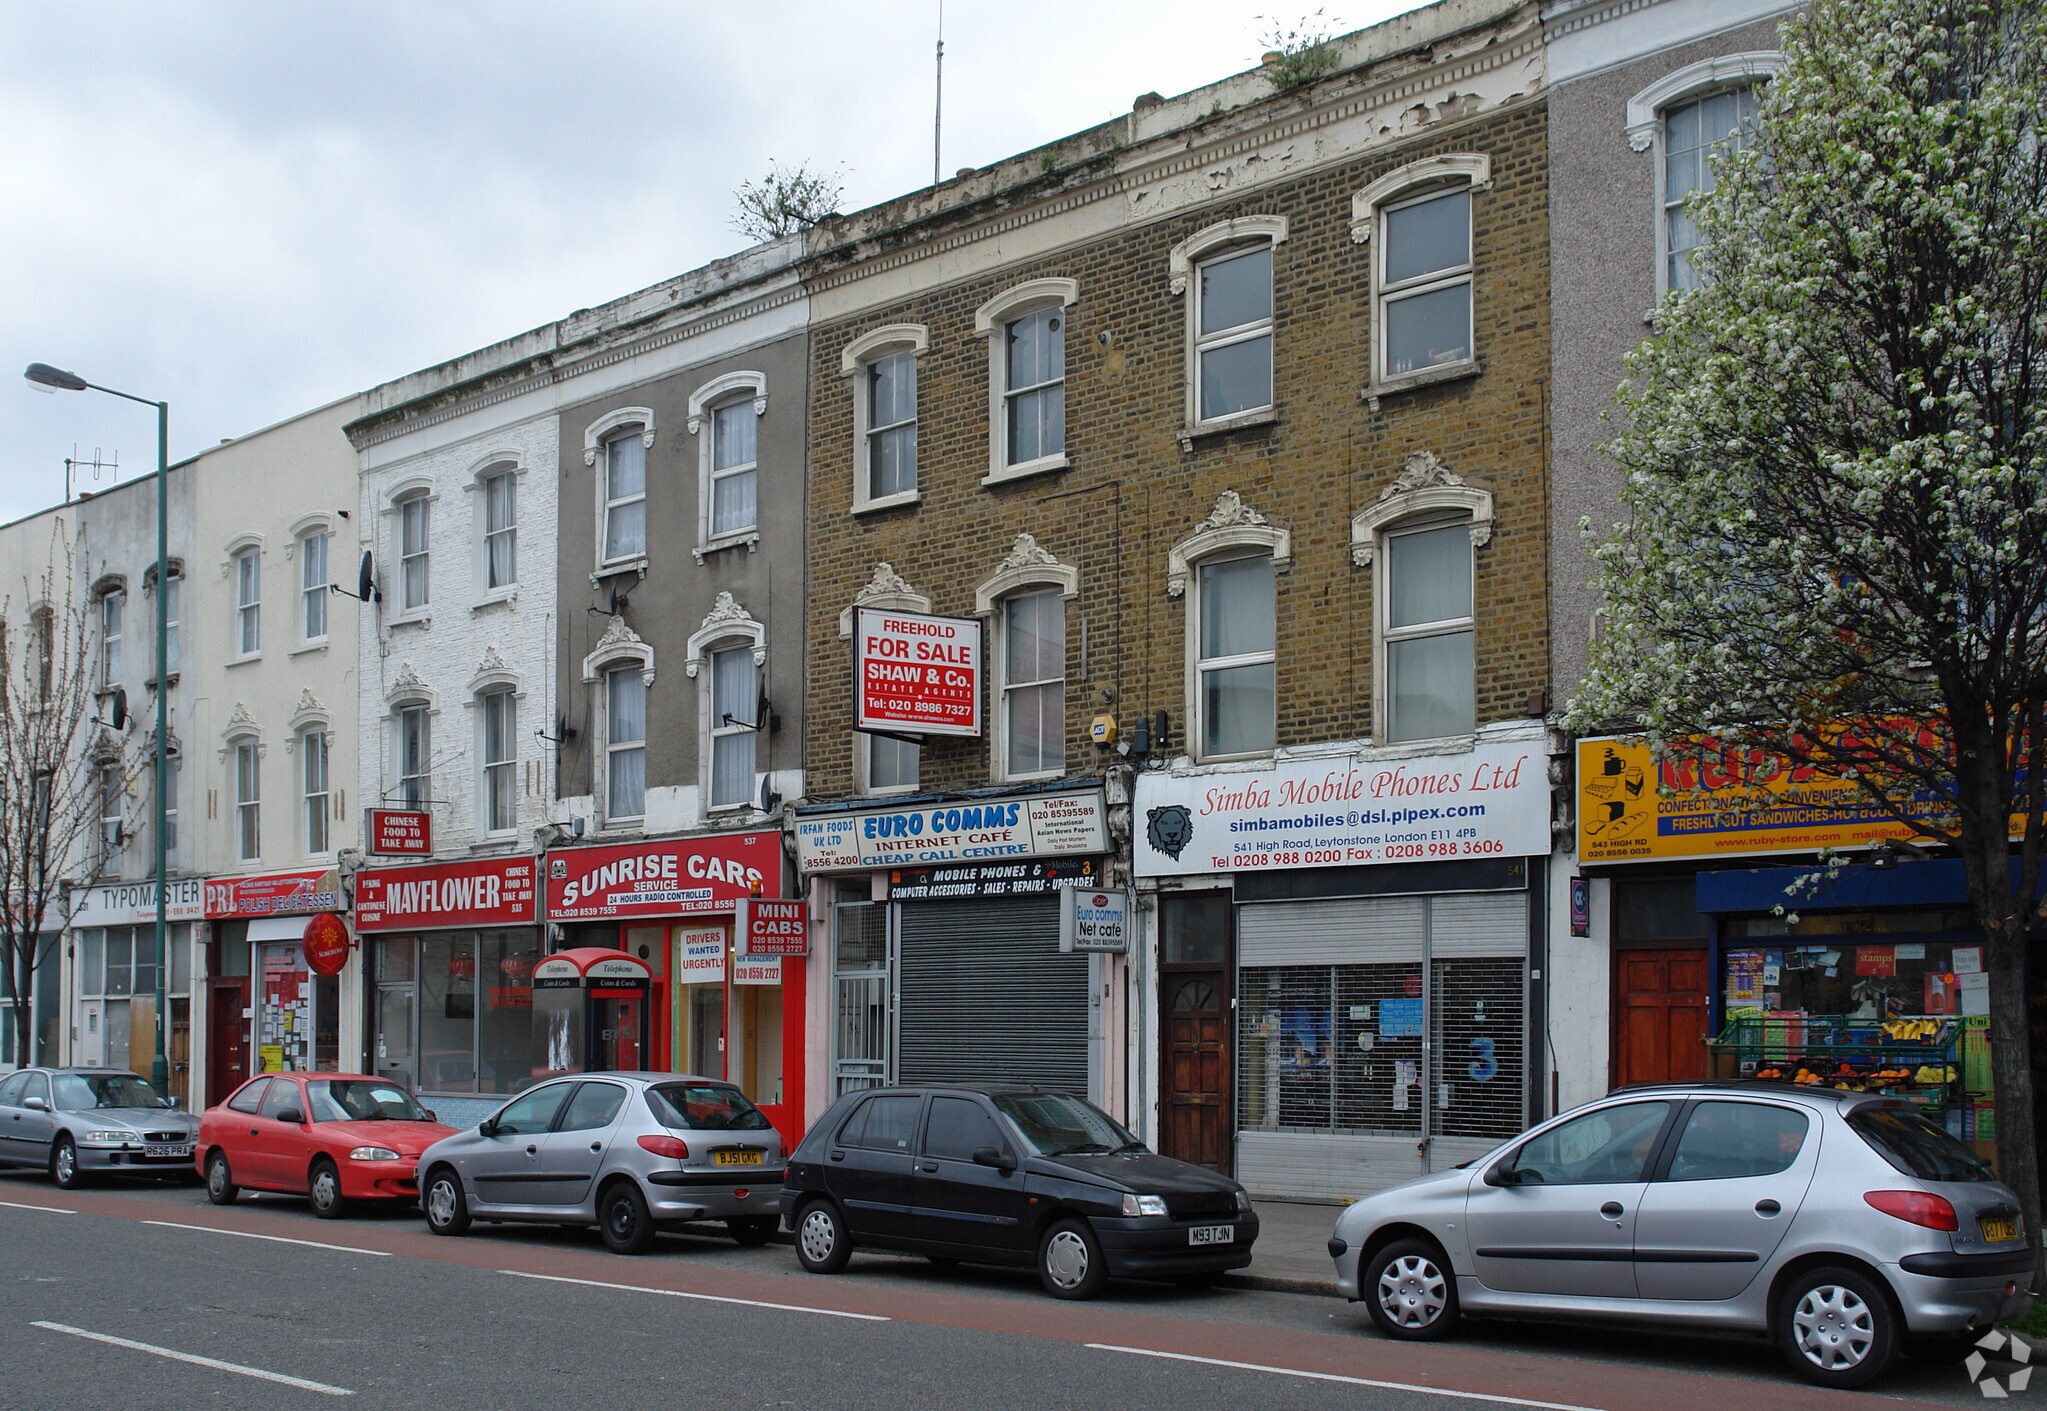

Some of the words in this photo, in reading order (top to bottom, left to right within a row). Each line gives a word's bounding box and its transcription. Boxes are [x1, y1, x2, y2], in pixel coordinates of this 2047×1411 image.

[884, 620, 955, 638] FREEHOLD
[867, 636, 909, 658] FOR
[916, 641, 971, 665] SALE
[868, 663, 921, 683] SHAW
[926, 668, 940, 685] &
[945, 670, 971, 688] Co.
[868, 682, 913, 693] ESTATE
[924, 687, 971, 698] AGENTS
[867, 697, 887, 709] Tel:
[888, 699, 911, 711] 020
[914, 702, 942, 713] 8986
[945, 704, 971, 716] 7327
[1199, 780, 1271, 816] Simba
[1278, 769, 1363, 807] Mobile
[1370, 765, 1462, 798] Phones
[1468, 755, 1529, 792] Ltd
[1043, 800, 1078, 809] Tel/Fax:
[1032, 811, 1048, 820] 020
[1050, 807, 1095, 818] 85395589
[1230, 804, 1486, 832] simbamobiles@dsl.pipex.com
[384, 816, 419, 827] CHINESE
[800, 823, 823, 835] IRFAN
[827, 821, 853, 832] FOODS
[864, 812, 923, 840] EURO
[931, 803, 1020, 833] COMMS
[1045, 819, 1084, 828] International
[1672, 817, 1719, 831] FRESHLY
[384, 825, 407, 836] FOOD
[409, 827, 420, 837] TO
[380, 839, 401, 848] TAKE
[404, 839, 424, 849] AWAY
[744, 837, 757, 845] 537
[813, 837, 825, 847] UK
[827, 835, 842, 846] LTD
[876, 835, 961, 852] INTERNET
[968, 829, 1013, 844] CAFÉ
[1234, 842, 1252, 853] 541
[1256, 840, 1280, 852] High
[1283, 838, 1313, 850] Road,
[1315, 835, 1381, 848] Leytonstone
[1385, 831, 1427, 843] London
[1431, 830, 1451, 840] E11
[1456, 828, 1477, 838] 4PB
[1592, 841, 1608, 849] 543
[1610, 839, 1632, 848] HIGH
[1714, 832, 1841, 848] www.ruby-store.com
[862, 852, 914, 866] CHEAP
[918, 848, 958, 861] CALL
[962, 843, 1028, 858] CENTRE
[1212, 856, 1229, 868] Tel
[1234, 854, 1269, 867] 0208
[1273, 852, 1300, 865] 988
[1305, 849, 1342, 863] 0200
[1347, 847, 1373, 860] Fax
[1385, 843, 1424, 859] 0208
[1428, 842, 1458, 856] 988
[1463, 839, 1503, 854] 3606
[1588, 850, 1604, 858] 020
[1630, 848, 1652, 856] 0035
[807, 858, 831, 868] 8556
[834, 855, 858, 866] 4200
[505, 866, 529, 877] CHINESE
[933, 868, 980, 882] MOBILE
[980, 865, 1026, 879] PHONES
[1033, 864, 1042, 876] &
[1082, 861, 1091, 876] 3
[1507, 865, 1524, 876] 541
[504, 880, 521, 889] FOOD
[522, 878, 530, 888] TO
[561, 854, 678, 907] SUNRISE
[686, 854, 765, 894] CARS
[634, 880, 678, 892] SERVICE
[103, 882, 199, 909] TYPOMASTER
[386, 874, 500, 915] MAYFLOWER
[502, 892, 516, 901] TAKE
[518, 890, 532, 900] AWAY
[892, 884, 928, 899] COMPUTER
[929, 880, 976, 897] ACCESSORIES
[983, 881, 1006, 895] SALES
[1012, 880, 1046, 893] REPAIRS
[205, 883, 238, 913] PRL
[239, 896, 270, 912] POLISH
[271, 891, 337, 911] DELICATESSEN
[609, 895, 617, 904] 24
[620, 894, 642, 903] HOURS
[644, 892, 665, 902] RADIO
[667, 890, 711, 900] CONTROLLED
[357, 901, 386, 911] CANTONESE
[550, 909, 578, 917] TEL:020
[579, 907, 597, 916] 8539
[599, 906, 617, 914] 7555
[681, 901, 712, 911] TEL:020
[714, 899, 735, 909] 8556
[758, 903, 799, 918] MINI
[361, 912, 381, 922] CUISINE
[1077, 905, 1094, 921] Euro
[1095, 909, 1123, 922] comms
[752, 920, 804, 935] CABS
[1080, 921, 1096, 936] Net
[1099, 922, 1121, 937] café
[686, 932, 720, 945] DRIVERS
[767, 936, 785, 944] 8539
[688, 945, 720, 955] WANTED
[683, 958, 725, 969] URGENTLY
[1860, 954, 1892, 965] stamps
[547, 965, 568, 973] Telephone
[603, 965, 633, 974] Telephone
[736, 968, 747, 979] 020
[748, 967, 763, 979] 8556
[764, 968, 779, 979] 2727
[1468, 1037, 1499, 1082] 3
[147, 1147, 170, 1155] R626
[171, 1146, 188, 1155] PRA
[720, 1152, 741, 1163] BJ51
[742, 1151, 758, 1163] GKG
[1193, 1228, 1210, 1242] M93
[1211, 1224, 1230, 1241] TJN
